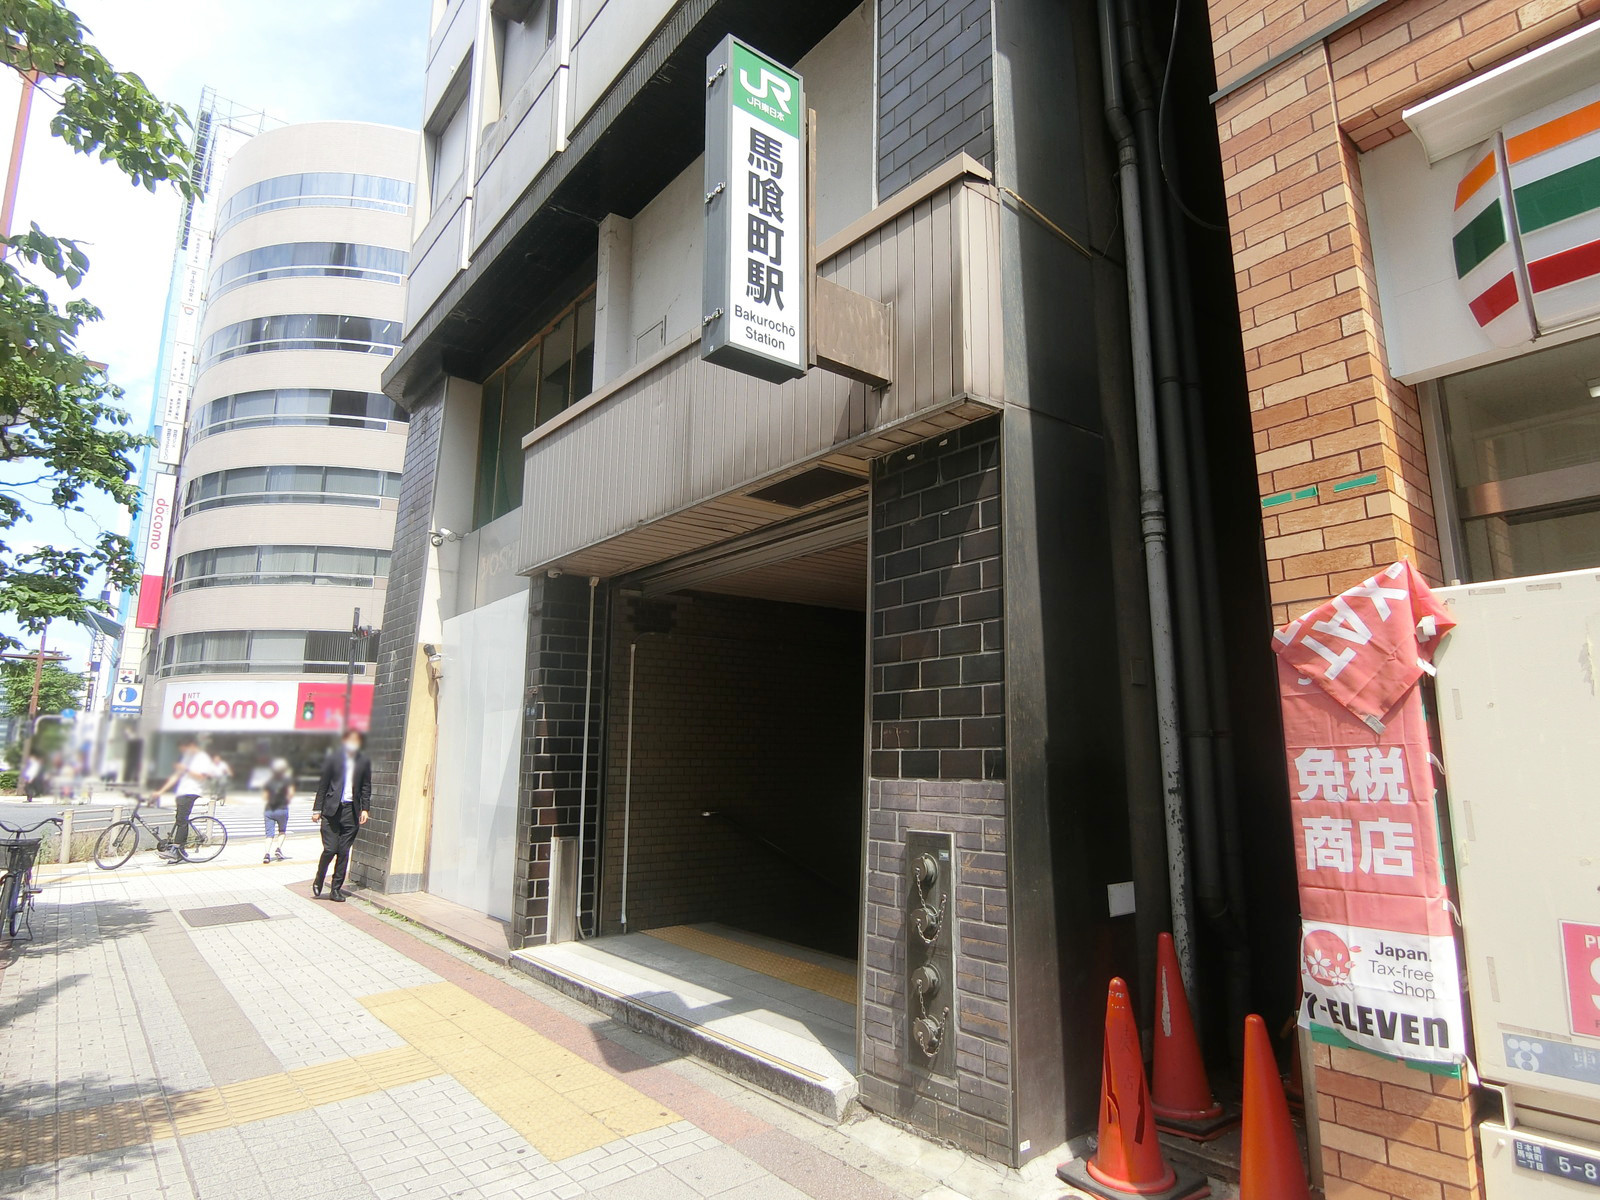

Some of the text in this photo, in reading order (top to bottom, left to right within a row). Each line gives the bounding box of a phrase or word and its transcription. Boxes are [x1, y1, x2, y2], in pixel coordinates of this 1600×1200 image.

[739, 68, 791, 115] JR
[746, 97, 785, 122] JR東日本
[746, 126, 785, 311] 馬喰町駅
[735, 304, 796, 337] Bakurochō
[745, 326, 785, 350] Station
[150, 498, 169, 550] docomo
[173, 693, 279, 719] docomo
[1294, 746, 1408, 805] 免税
[1301, 815, 1414, 877] 商店
[1374, 942, 1433, 963] Japan.
[1368, 959, 1434, 982] Tax-free
[1392, 980, 1436, 1002] Shop
[1516, 1141, 1541, 1154] 日本橋
[1517, 1149, 1542, 1162] 馬喰町
[1518, 1159, 1544, 1171] 一丁目
[1558, 1155, 1597, 1179] 5-8
